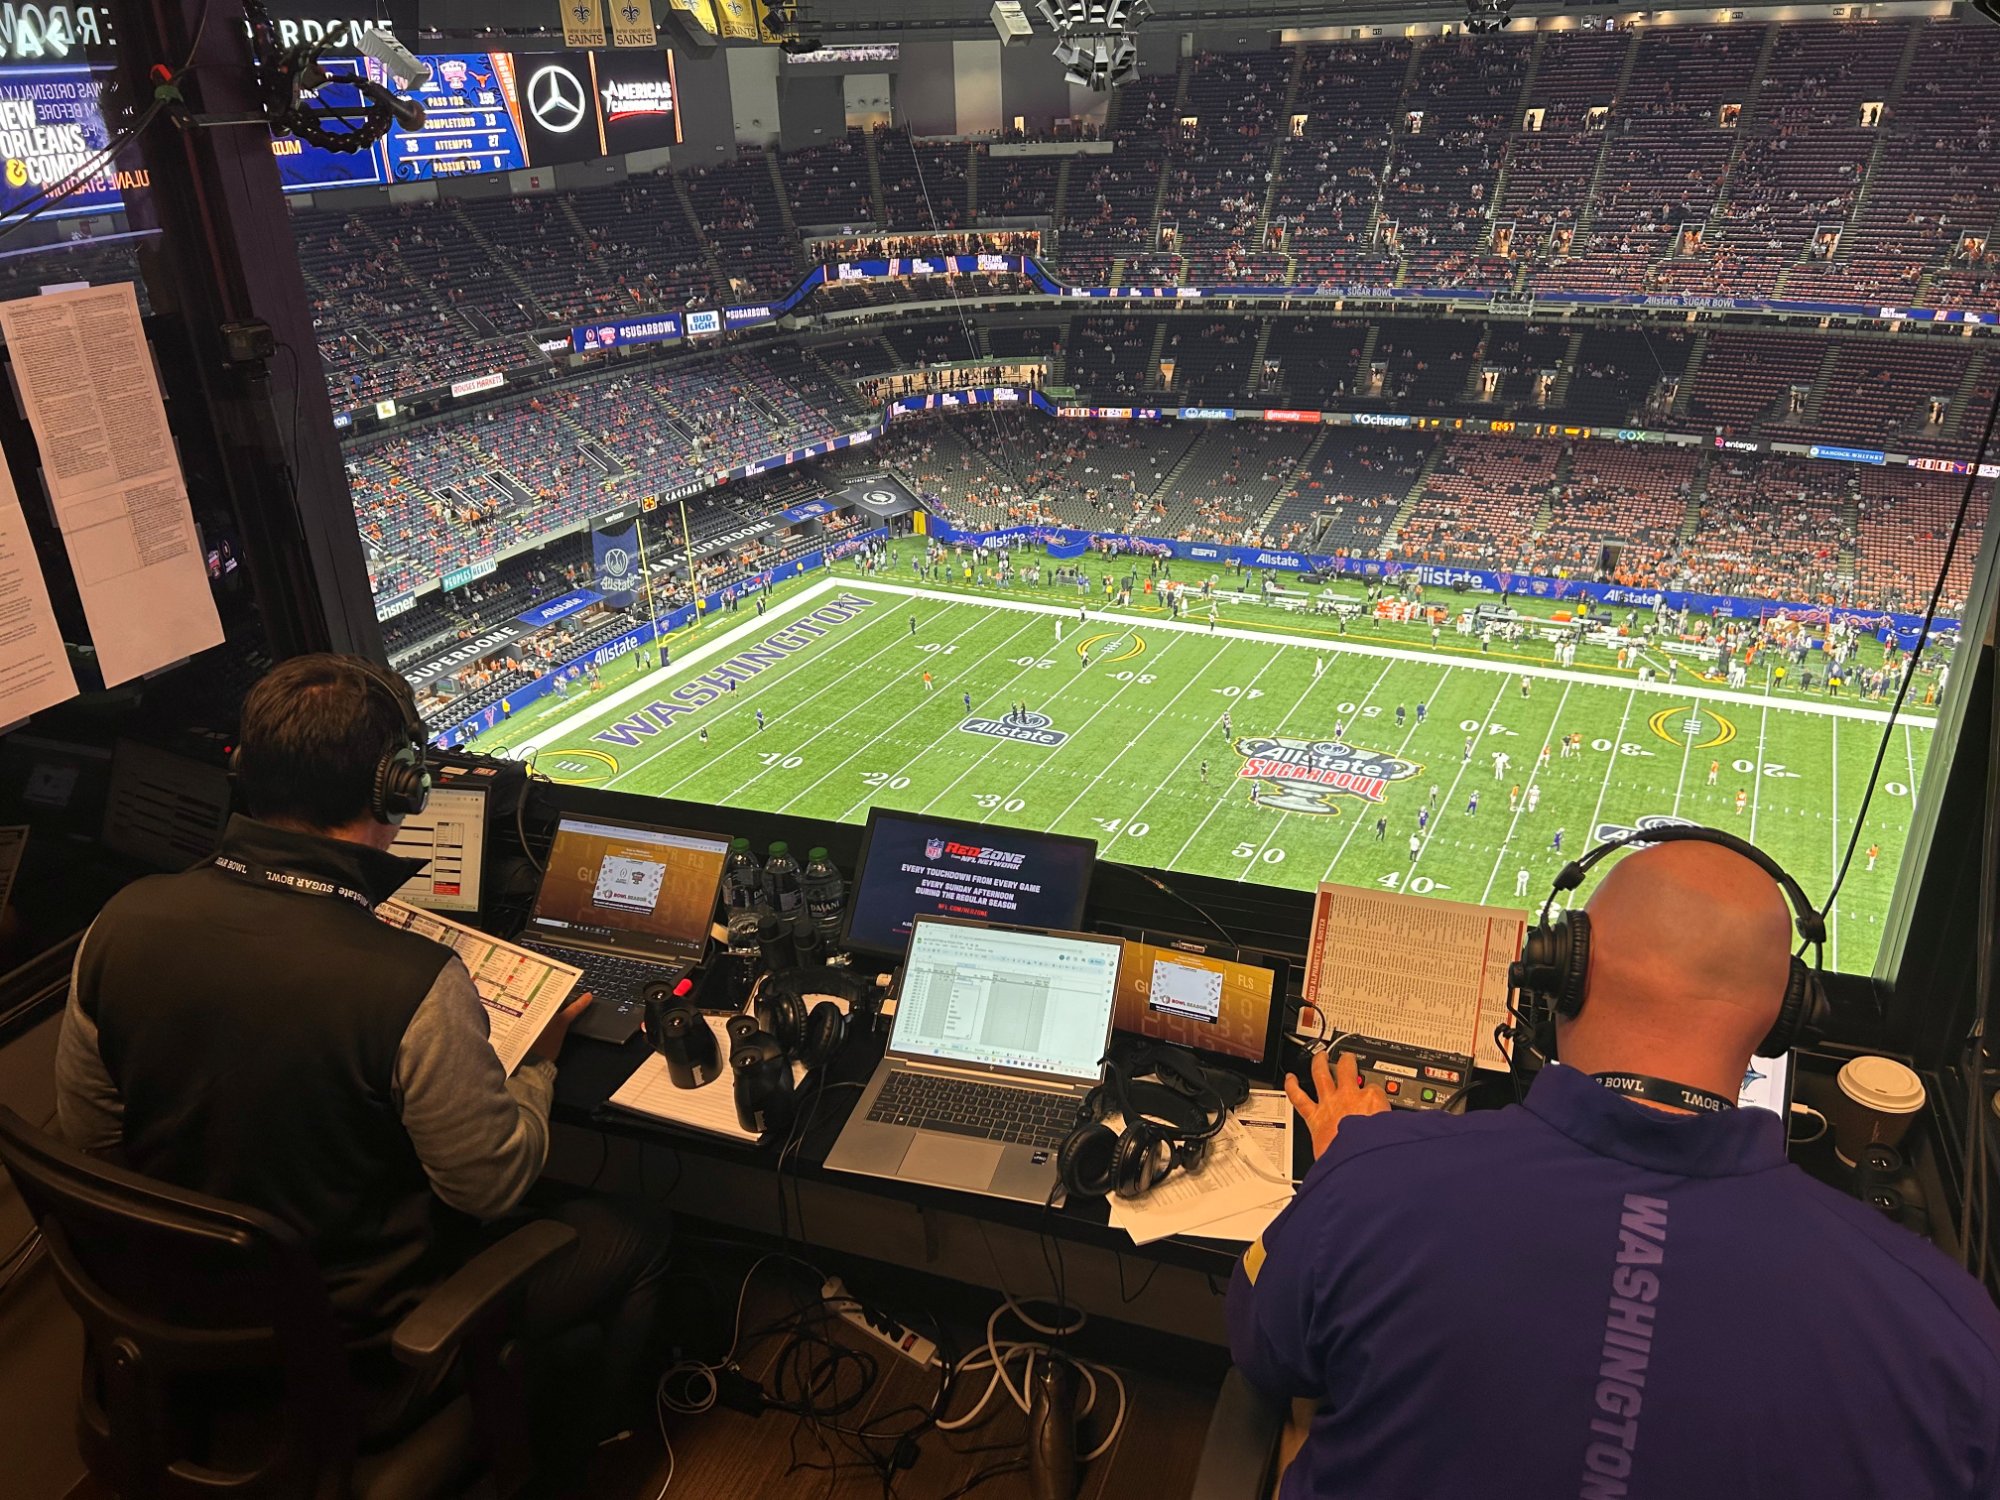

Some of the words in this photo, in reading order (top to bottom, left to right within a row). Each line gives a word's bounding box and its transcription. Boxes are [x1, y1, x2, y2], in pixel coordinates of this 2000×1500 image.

[724, 25, 756, 37] SAINTS
[568, 33, 604, 45] SAINTS
[616, 33, 653, 45] SAINTS
[428, 96, 448, 107] PASS
[424, 117, 476, 129] COMPLETIONS
[0, 125, 87, 160] ORLEANS
[435, 138, 473, 151] ATTEMPTS
[1347, 287, 1370, 296] SUGAR
[1372, 287, 1393, 297] BOWL
[1644, 296, 1679, 306] Allstate
[1683, 297, 1711, 306] SUGAR
[1712, 298, 1736, 308] BOWL
[692, 313, 713, 324] BUD
[726, 307, 771, 320] #SUGARBOWL
[620, 320, 676, 338] #SUGARBOWL
[689, 321, 717, 332] LIGHT
[453, 382, 476, 394] ROUSES
[477, 375, 503, 389] MARKETS
[1198, 408, 1227, 418] Allstate
[1361, 414, 1408, 427] Ochsner
[1618, 430, 1646, 441] COX
[1725, 441, 1758, 451] entergy
[1852, 452, 1884, 461] WHITNEY
[665, 481, 703, 503] CAESARS
[644, 497, 655, 508] 25
[604, 511, 624, 523] verizon
[683, 520, 776, 557] SUPERDOME
[1191, 547, 1217, 558] ESPN
[1256, 553, 1299, 567] Allstate
[444, 569, 471, 589] PEOPLES
[471, 559, 495, 578] HEALTH
[600, 572, 635, 592] Allstate
[541, 597, 583, 619] Allstate
[405, 625, 519, 685] SUPERDOME
[594, 635, 639, 666] Allstate
[589, 591, 878, 748] WASHINGTON
[967, 720, 1055, 744] Allstate
[1254, 746, 1383, 778] Allstate
[1240, 757, 1321, 782] SUGAR
[1319, 769, 1388, 801] BOWL
[1231, 841, 1286, 864] 50
[961, 855, 977, 864] NFL
[977, 857, 1021, 870] NETWORK
[265, 870, 295, 886] BOWL
[296, 877, 335, 893] SUGAR
[901, 863, 926, 875] EVERY
[926, 867, 972, 882] TOUCHDOWN
[972, 875, 992, 886] FROM
[993, 878, 1019, 890] EVERY
[1019, 882, 1042, 894] GAME
[921, 879, 945, 889] EVERY
[945, 882, 973, 895] SUNDAY
[973, 887, 1015, 902] AFTERNOON
[915, 886, 941, 898] DURING
[942, 891, 956, 900] THE
[955, 893, 988, 906] REGULAR
[988, 898, 1018, 911] SEASON
[810, 900, 840, 913] DASANI
[1384, 1075, 1404, 1083] COUGH
[1604, 1077, 1645, 1093] BOWL
[1681, 1090, 1721, 1112] BOWL
[1580, 1193, 1669, 1500] WASHINGTON
